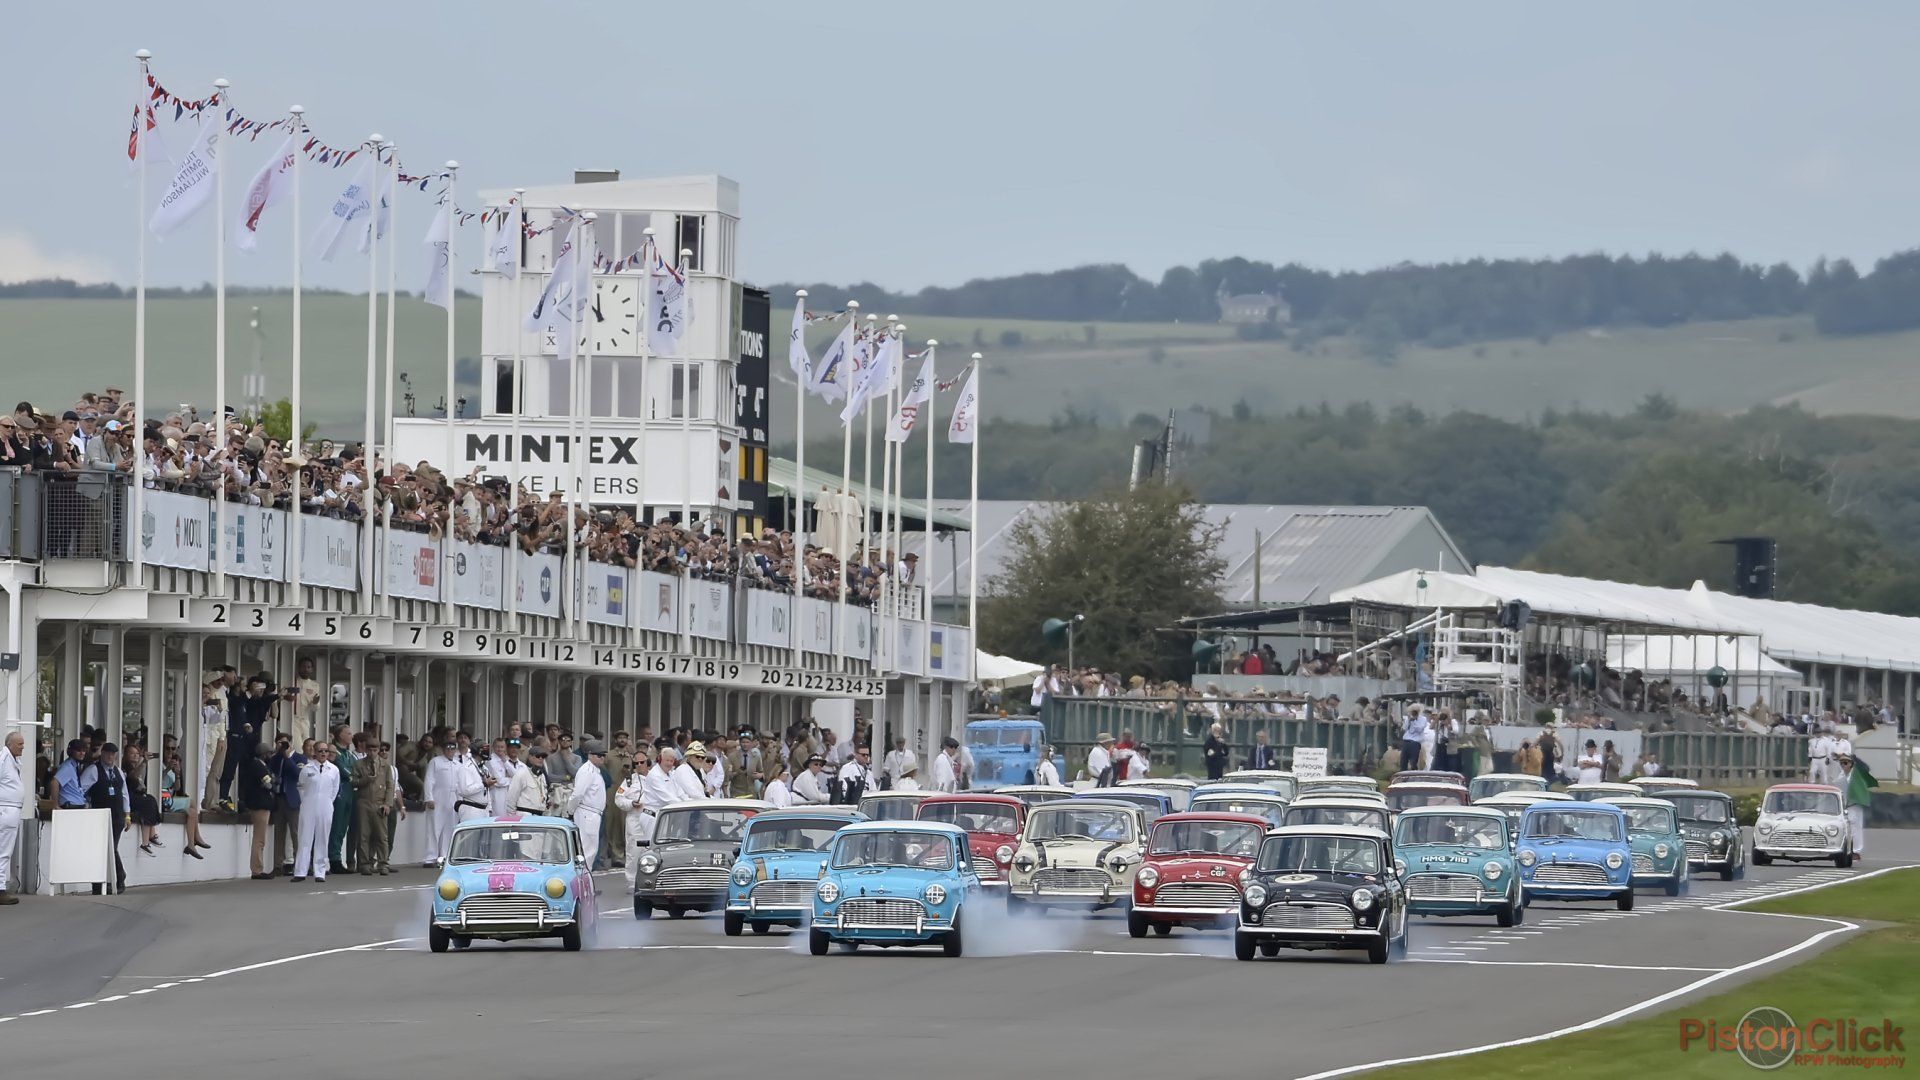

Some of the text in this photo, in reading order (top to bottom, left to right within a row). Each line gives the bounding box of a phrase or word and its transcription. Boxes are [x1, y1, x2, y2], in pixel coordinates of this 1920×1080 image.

[466, 433, 638, 465] MINTEX
[180, 599, 184, 618] 1
[212, 604, 225, 623] 2
[251, 608, 264, 627] 3
[288, 613, 301, 632] 4
[325, 618, 336, 635] 5
[359, 621, 372, 638] 6
[410, 627, 422, 643] 7
[443, 631, 454, 647] 8
[476, 634, 487, 651] 9
[496, 638, 516, 655] 10
[530, 641, 546, 658] 11
[555, 645, 574, 661] 12
[594, 650, 614, 666] 14
[622, 653, 641, 669] 15
[646, 655, 666, 671] 16
[672, 658, 690, 673] 17
[696, 660, 715, 676] 18
[721, 664, 739, 679] 19
[761, 669, 781, 684] 20
[785, 672, 802, 687] 21
[805, 675, 823, 689] 22
[826, 677, 844, 691] 23
[846, 680, 862, 693] 24
[866, 682, 884, 695] 25
